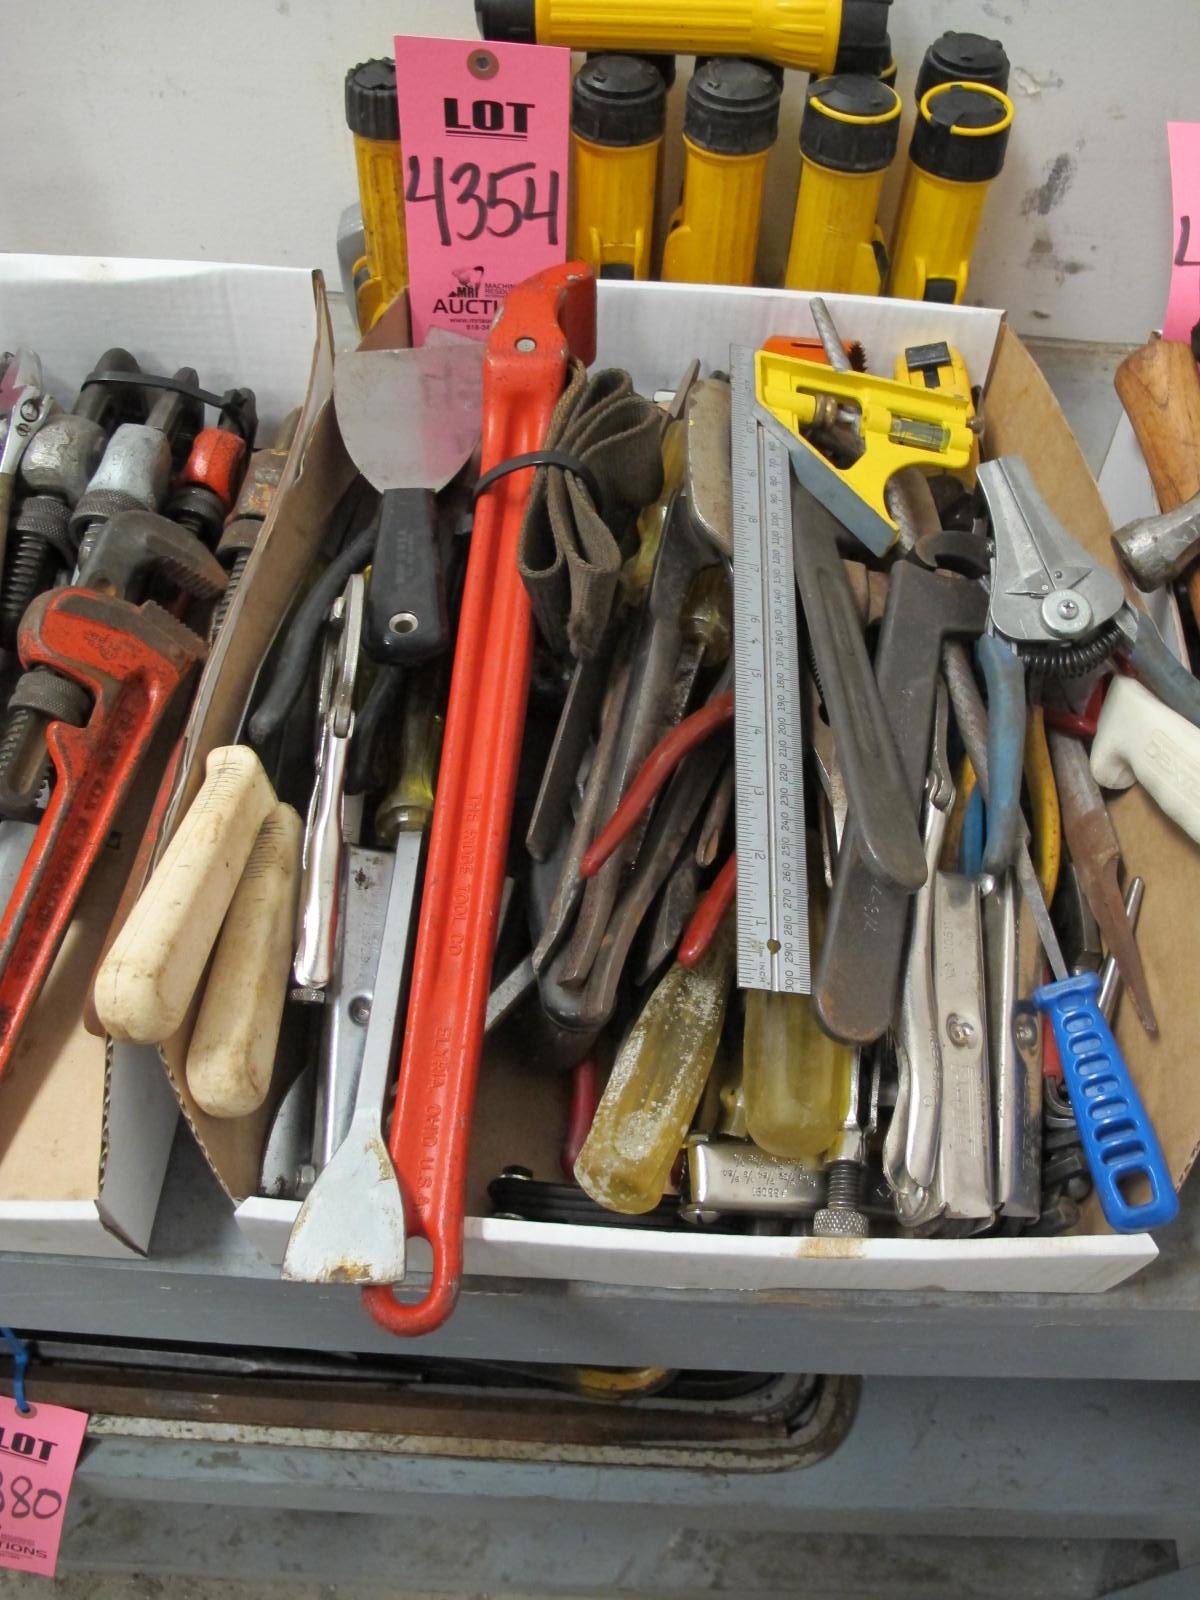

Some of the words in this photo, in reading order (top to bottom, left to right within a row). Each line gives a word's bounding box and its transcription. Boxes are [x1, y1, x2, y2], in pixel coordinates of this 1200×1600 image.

[443, 97, 535, 134] LOT
[406, 155, 560, 246] 4354
[457, 283, 480, 298] MRI
[774, 589, 783, 604] 140
[774, 609, 783, 625] 150
[775, 629, 784, 646] 160
[775, 650, 784, 667] 170
[776, 672, 785, 689] 180
[776, 694, 786, 711] 190
[777, 717, 787, 735] 200
[778, 739, 788, 758] 210
[780, 763, 789, 782] 220
[780, 787, 789, 806] 230
[780, 811, 790, 831] 240
[781, 836, 791, 856] 250
[782, 862, 792, 882] 260
[455, 884, 472, 920] TOOL
[782, 888, 793, 909] 270
[783, 915, 793, 935] 280
[784, 942, 794, 963] 290
[784, 970, 794, 991] 300
[421, 1105, 442, 1147] OHIO
